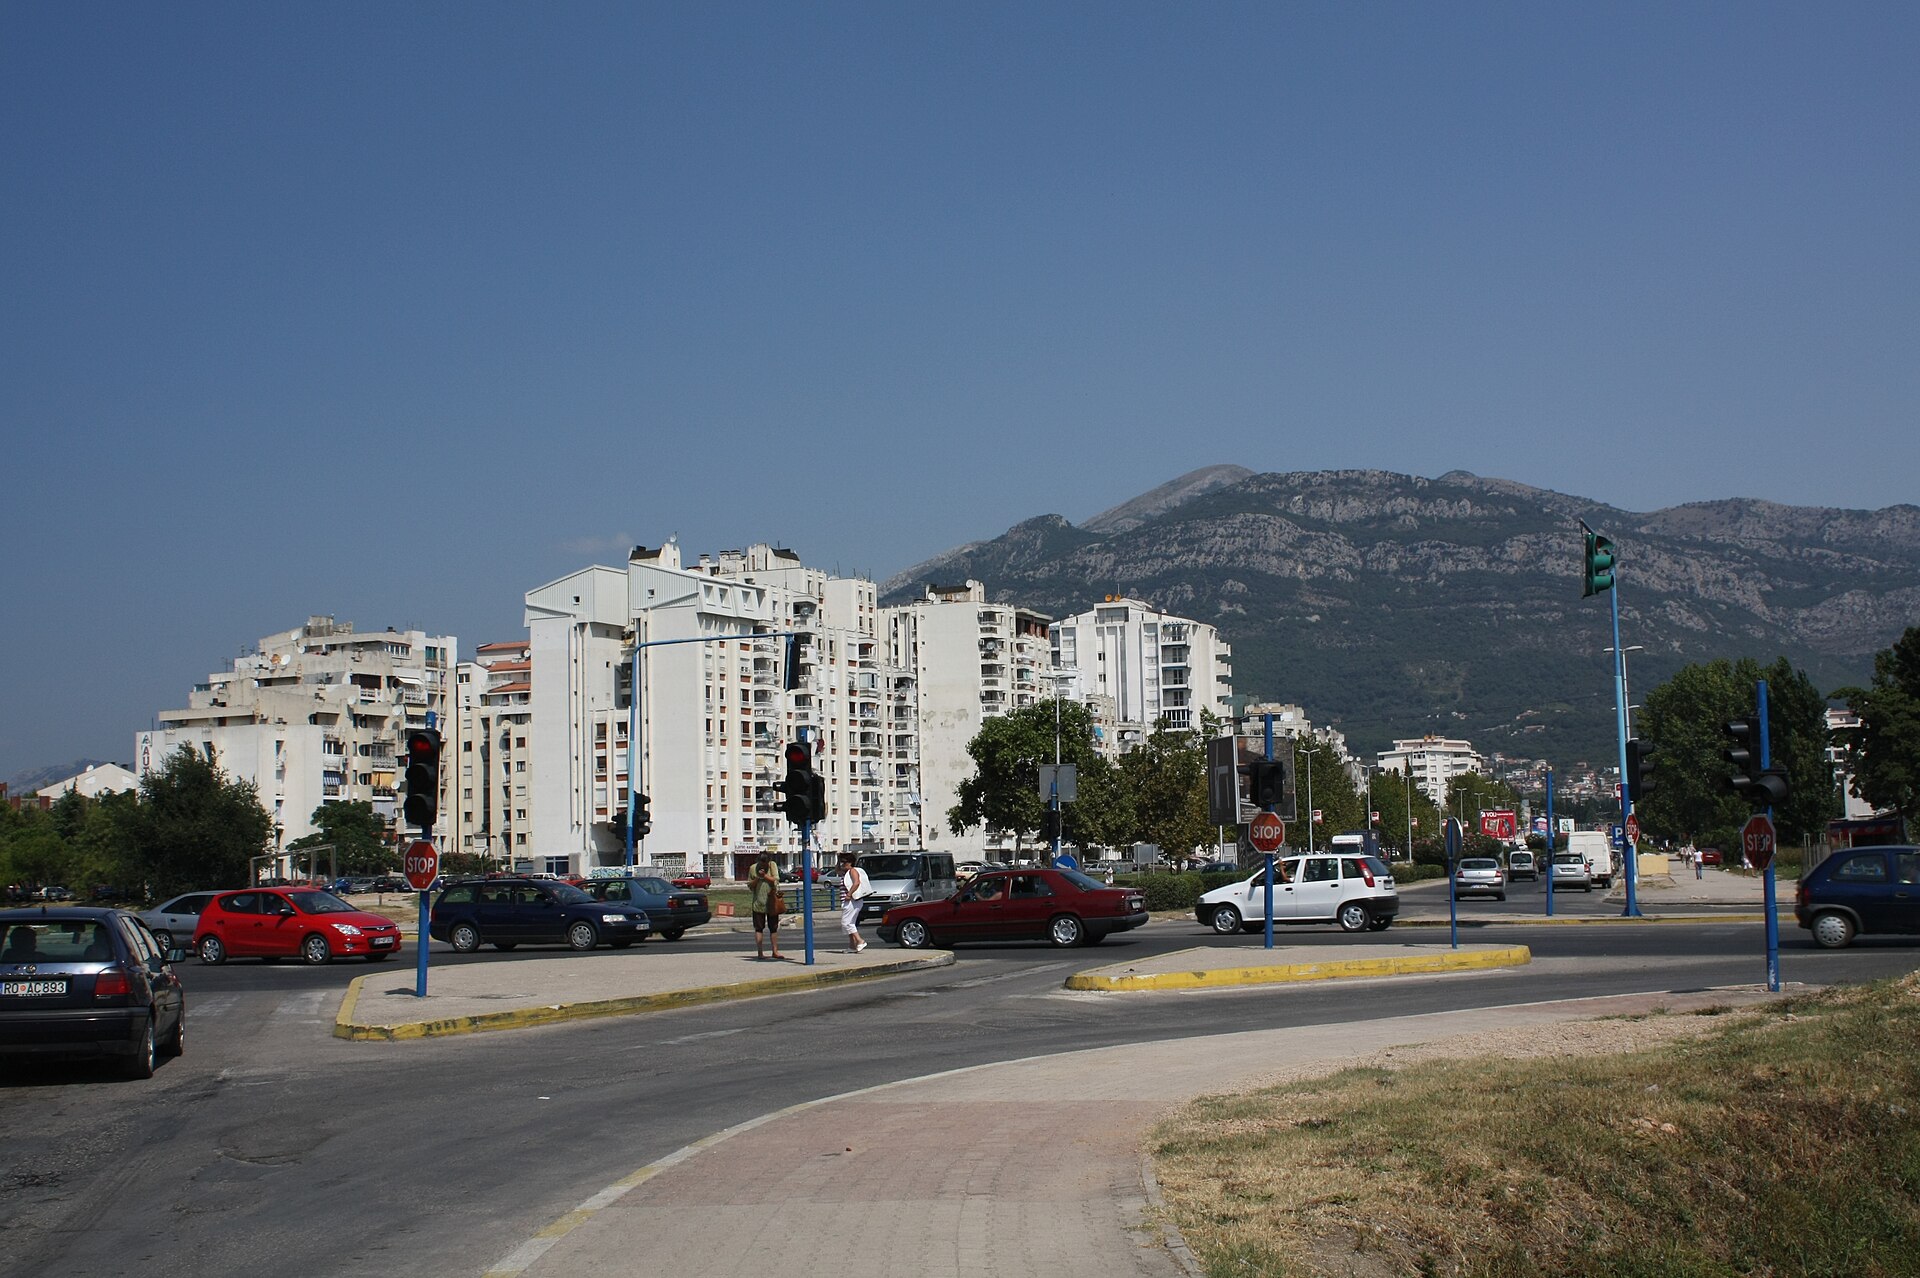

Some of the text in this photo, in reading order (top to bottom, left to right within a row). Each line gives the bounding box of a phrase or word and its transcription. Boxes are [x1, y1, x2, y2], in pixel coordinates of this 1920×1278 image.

[1253, 825, 1280, 839] STOP
[1615, 827, 1623, 838] P
[408, 856, 434, 873] STOP
[4, 981, 65, 994] RO AC893
